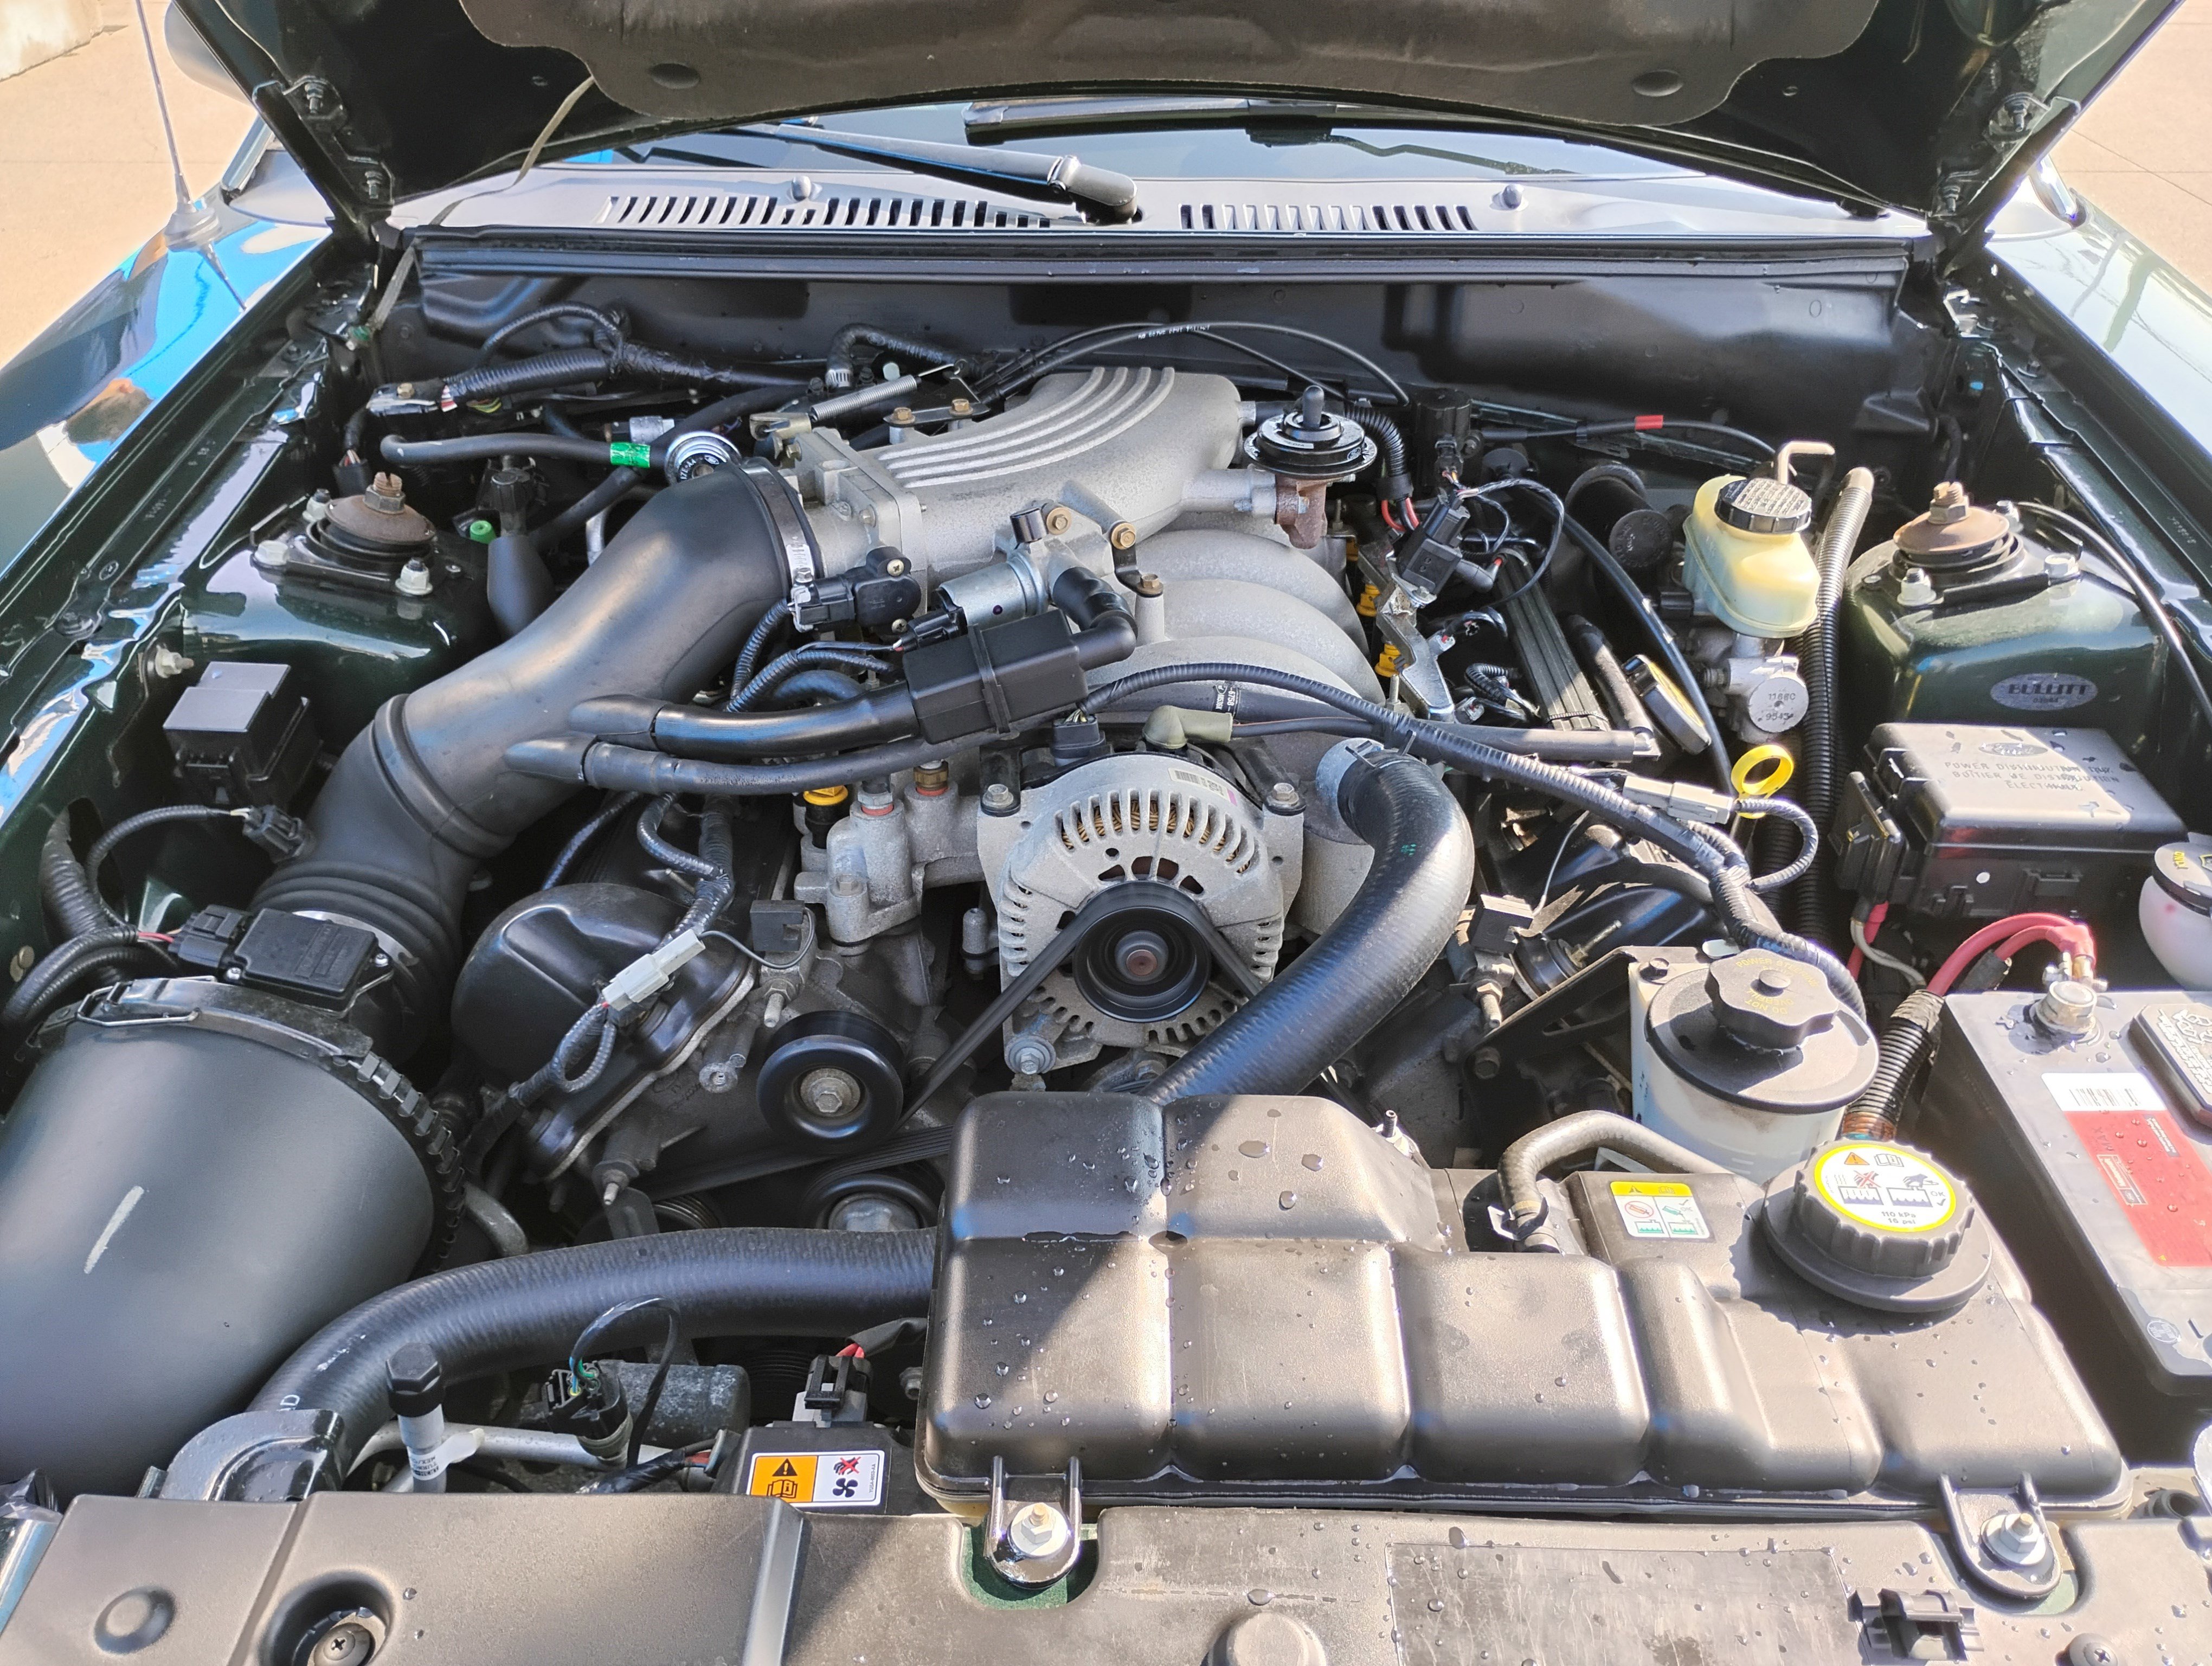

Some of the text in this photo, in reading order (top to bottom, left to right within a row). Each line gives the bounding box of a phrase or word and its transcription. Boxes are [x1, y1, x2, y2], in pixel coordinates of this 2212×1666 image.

[2008, 683, 2087, 695] BULLITT
[1945, 761, 1990, 770] POWER
[1735, 958, 1772, 967] POWER
